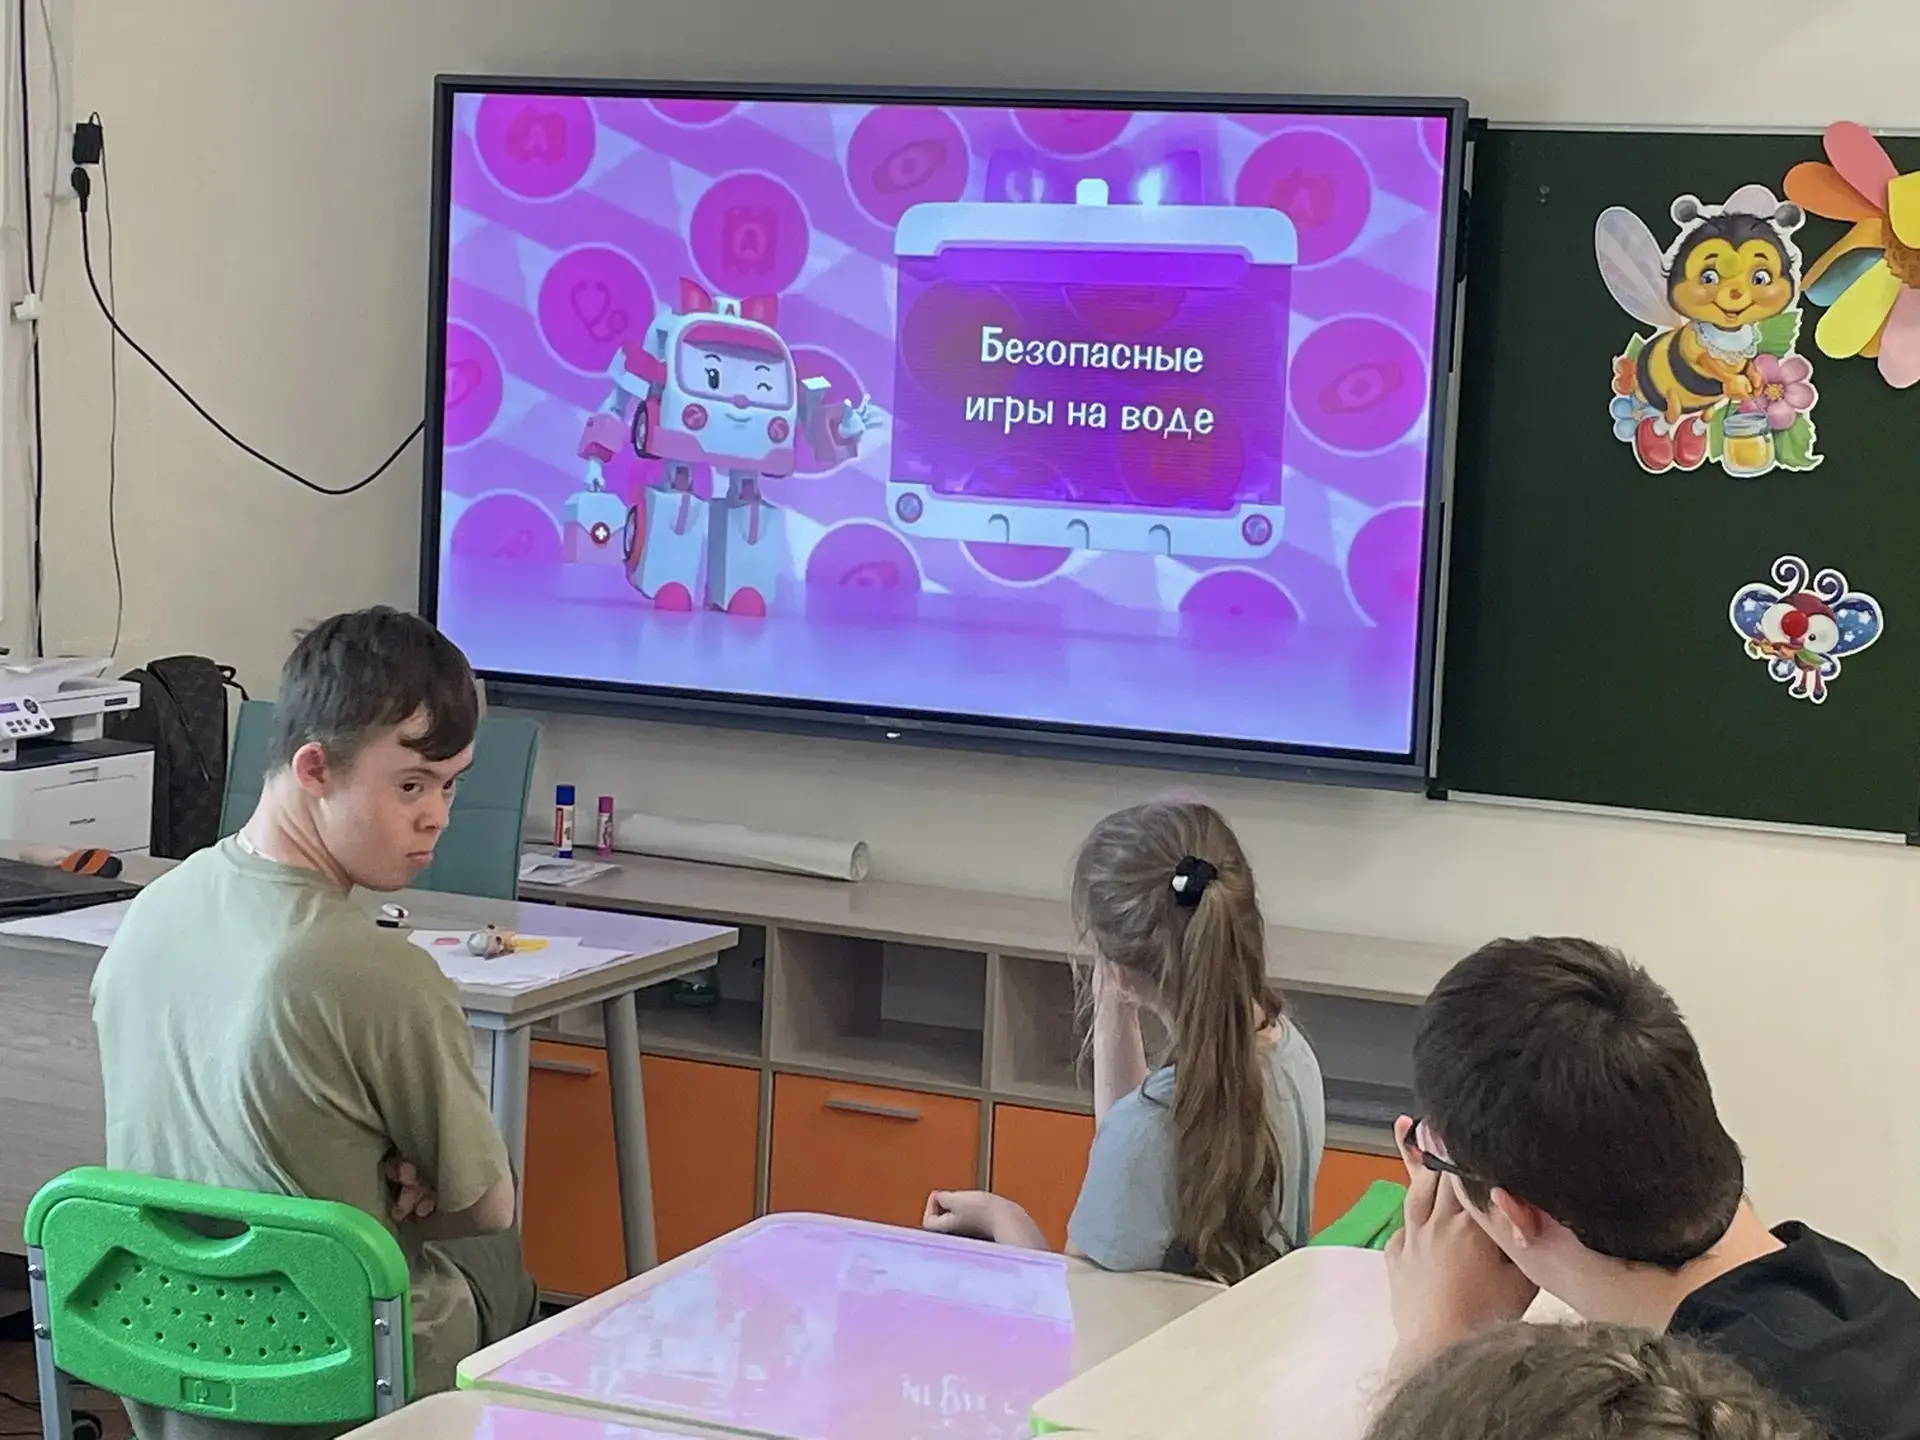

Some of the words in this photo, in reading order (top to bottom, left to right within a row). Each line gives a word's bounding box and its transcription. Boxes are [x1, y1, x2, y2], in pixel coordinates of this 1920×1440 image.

[980, 325, 1205, 374] Безопасные
[964, 395, 1054, 435] игры
[1067, 400, 1107, 429] на
[1120, 404, 1216, 441] воде
